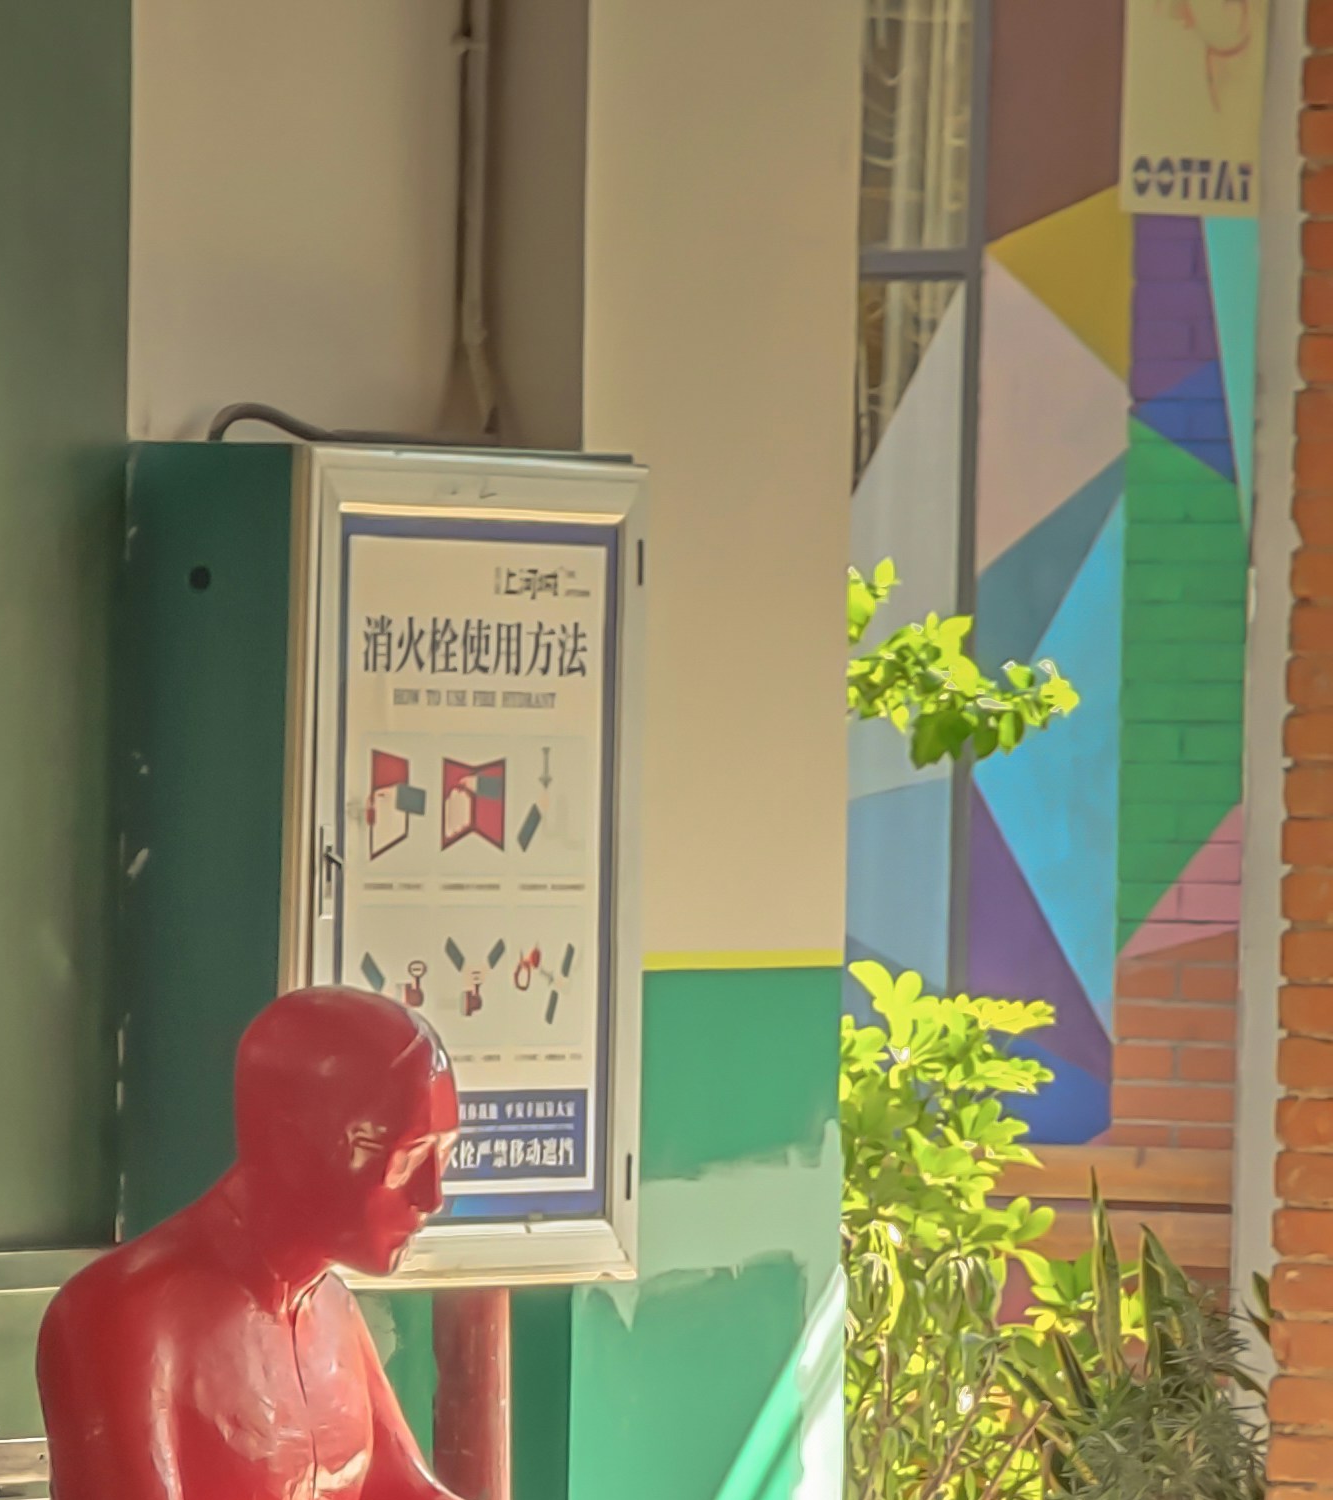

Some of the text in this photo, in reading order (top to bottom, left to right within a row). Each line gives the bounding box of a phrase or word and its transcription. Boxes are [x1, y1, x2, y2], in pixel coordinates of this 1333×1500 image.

[362, 615, 588, 677] 消火栓使用方法
